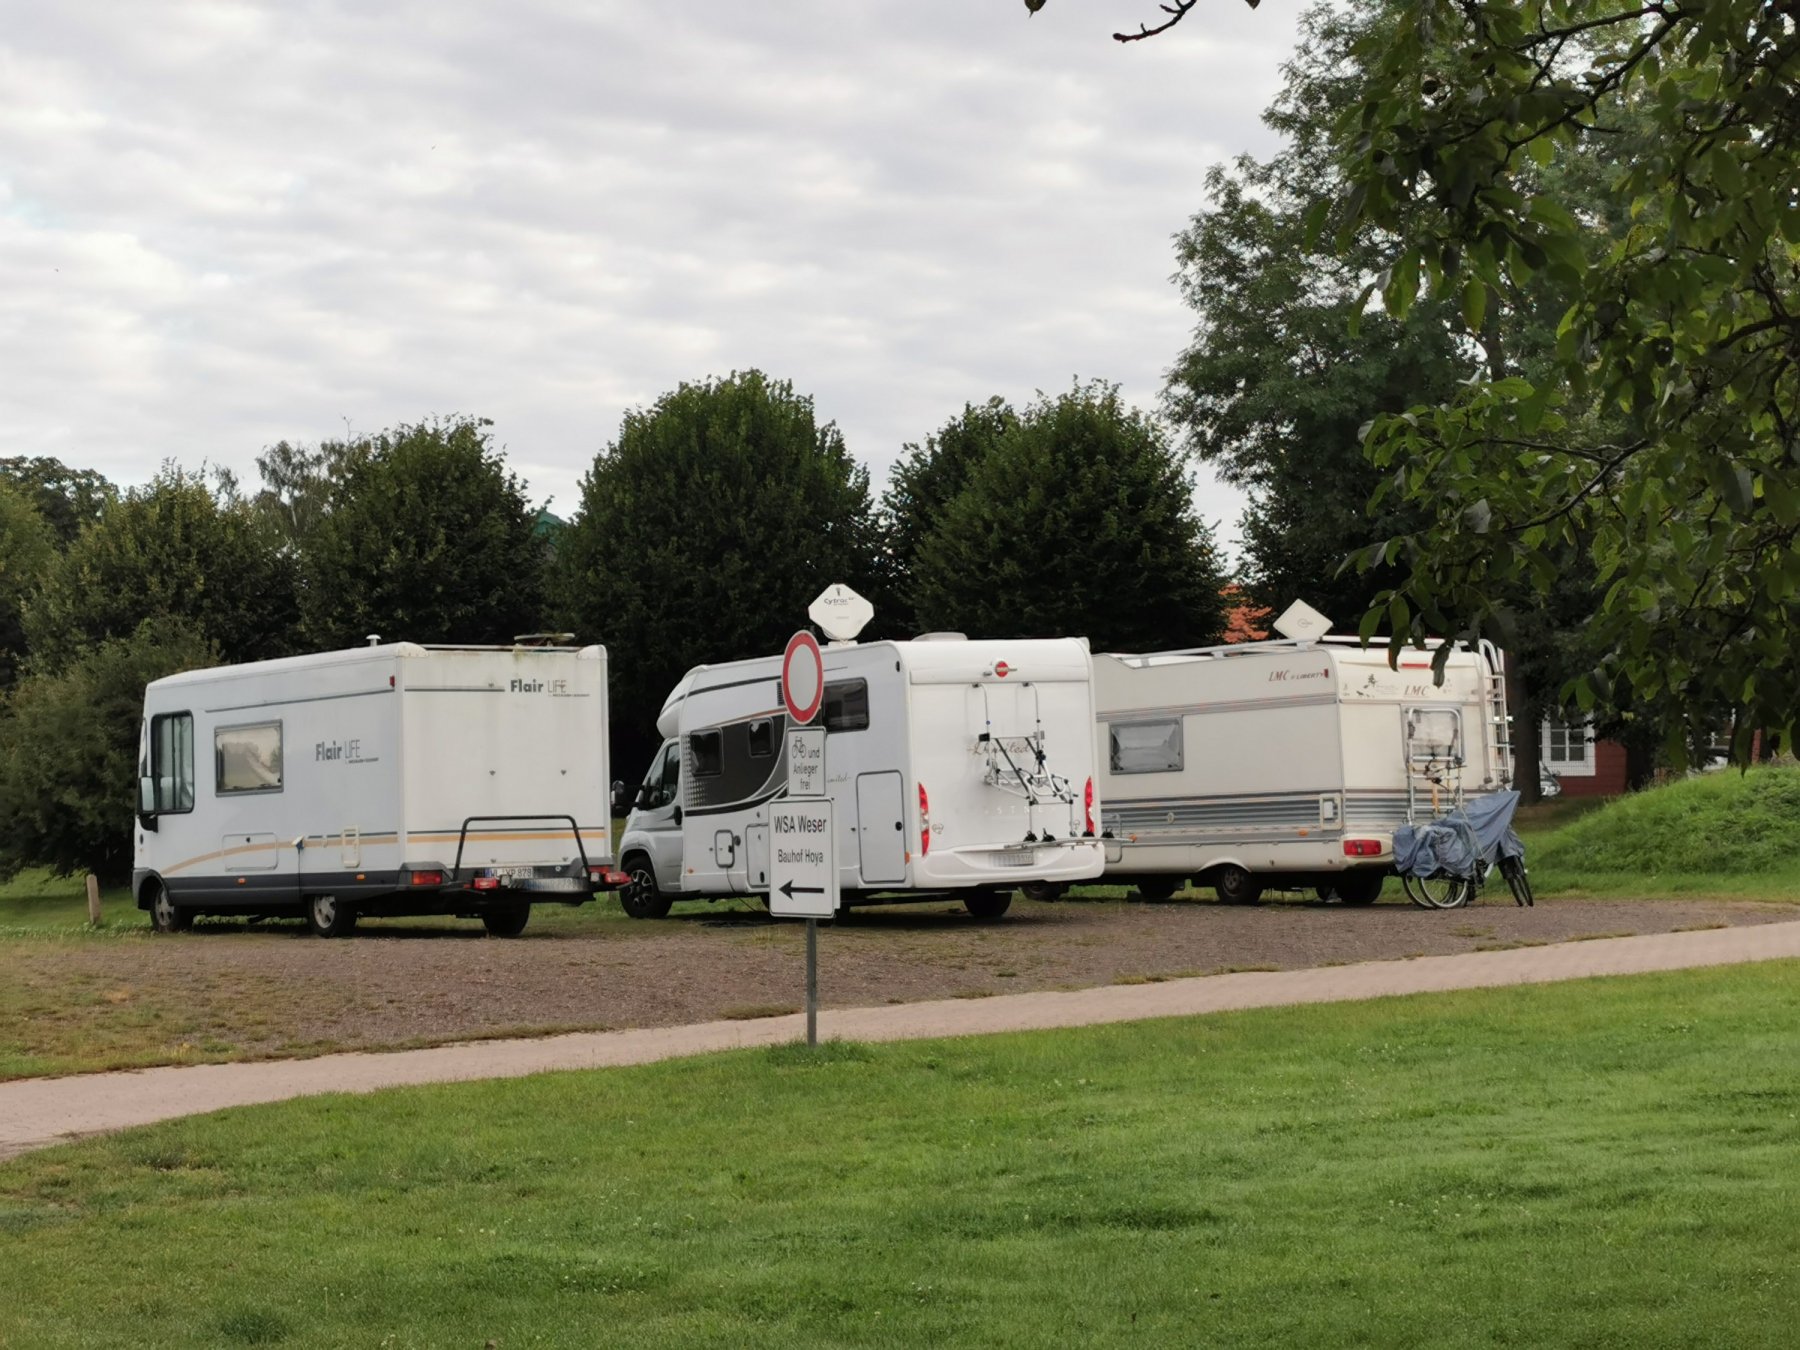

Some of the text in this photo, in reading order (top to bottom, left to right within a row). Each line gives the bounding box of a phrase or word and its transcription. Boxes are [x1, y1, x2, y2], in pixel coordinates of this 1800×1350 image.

[1269, 669, 1290, 681] LMC
[510, 678, 567, 693] Flair LIFE
[1404, 684, 1430, 697] LMC
[315, 739, 361, 761] Flair LIFE
[807, 746, 820, 759] und
[793, 762, 818, 777] Anlieger
[800, 777, 811, 790] frei
[773, 814, 827, 834] WSA Weser
[777, 848, 824, 867] Bauhof Hoya
